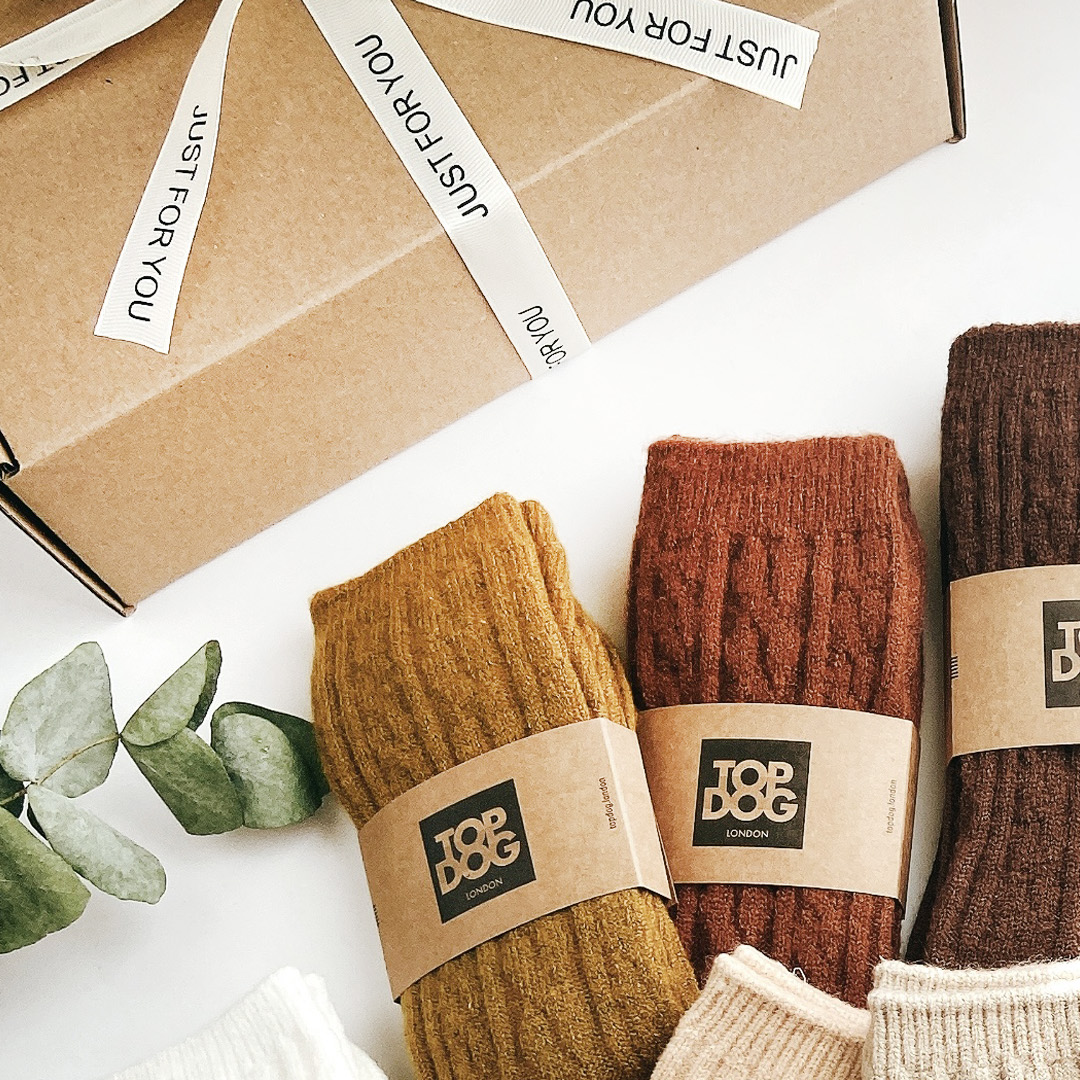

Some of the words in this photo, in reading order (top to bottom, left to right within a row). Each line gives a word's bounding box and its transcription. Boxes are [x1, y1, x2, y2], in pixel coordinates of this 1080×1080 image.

[570, 0, 635, 34] YOU
[645, 12, 712, 53] FOR
[354, 34, 404, 95] YOU
[715, 34, 798, 79] JUST
[174, 104, 208, 181] JUST
[393, 89, 443, 152] FOR
[427, 152, 489, 218] JUST
[148, 187, 189, 248] FOR
[128, 256, 167, 322] YOU
[518, 305, 555, 345] YOU
[539, 338, 567, 369] OR
[713, 759, 795, 789] TOP
[702, 786, 799, 823] DOG
[434, 806, 508, 858] TOP
[726, 829, 769, 839] LONDON
[435, 830, 521, 896] DOG
[465, 877, 504, 901] LONDON
